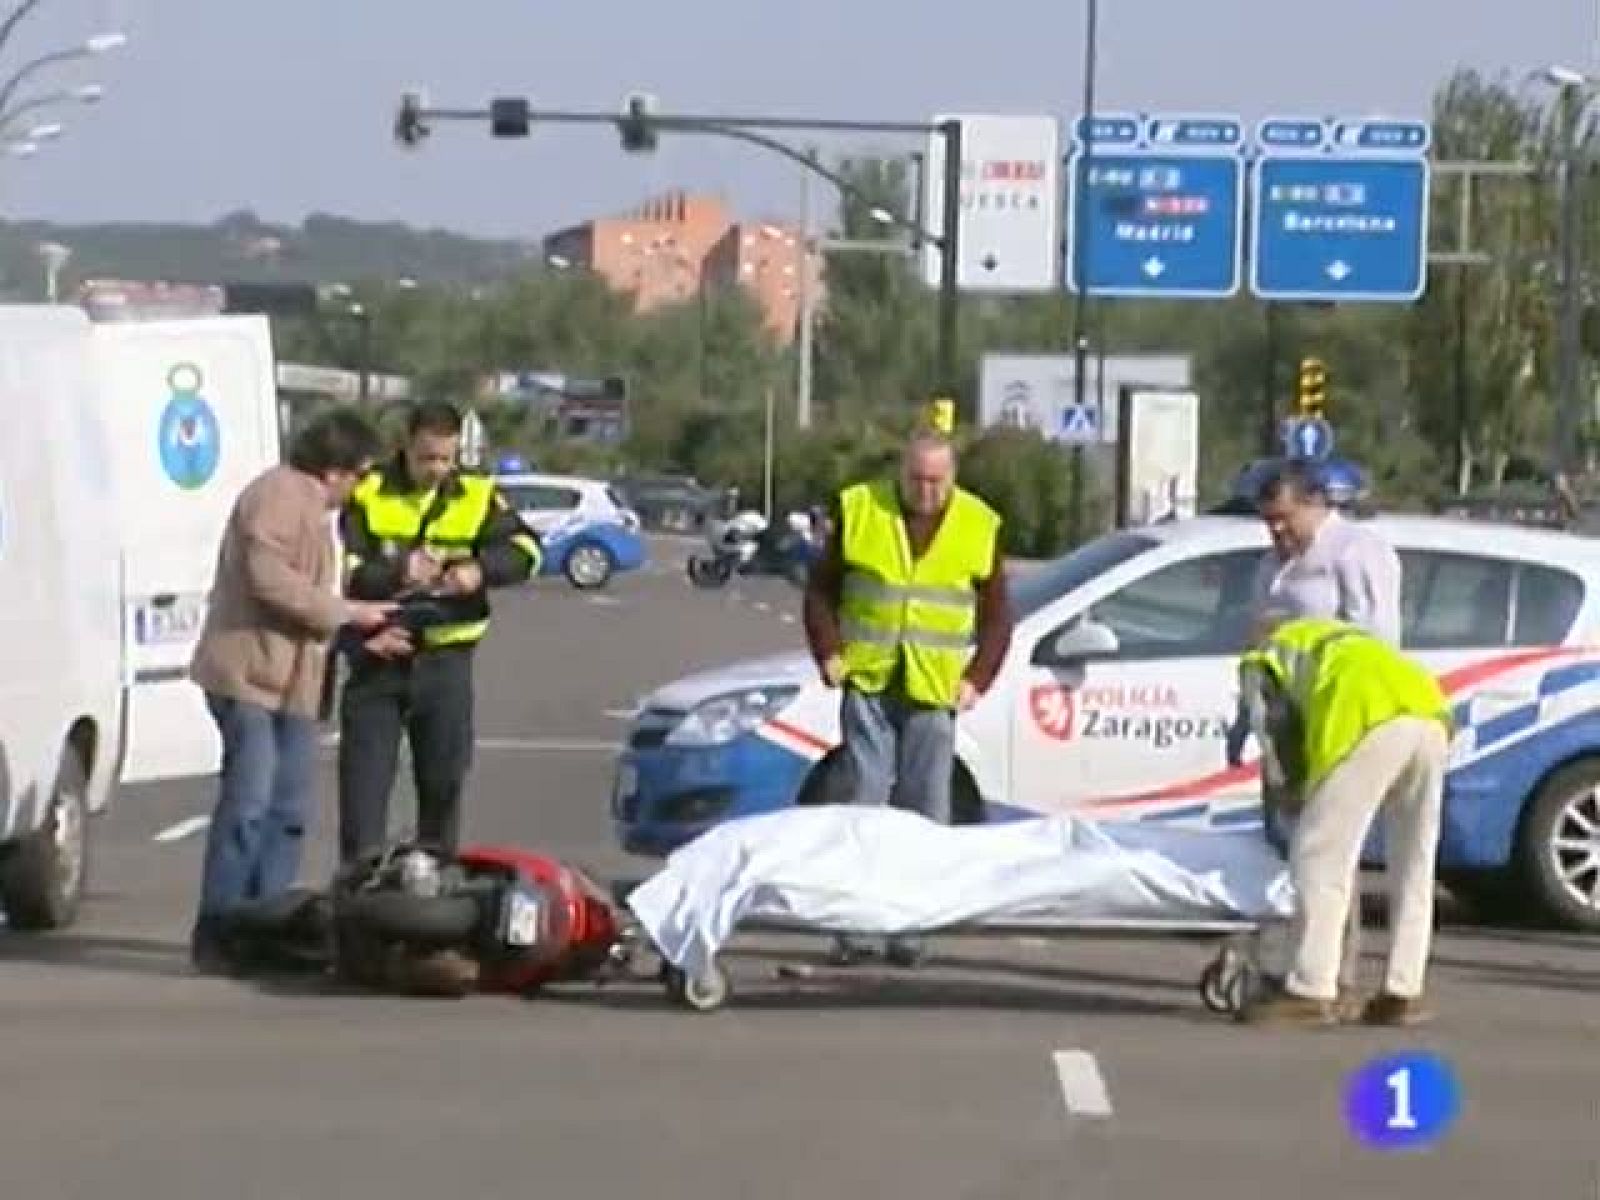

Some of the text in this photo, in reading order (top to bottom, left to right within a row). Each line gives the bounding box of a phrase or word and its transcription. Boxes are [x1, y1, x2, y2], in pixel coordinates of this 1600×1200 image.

[960, 191, 1039, 210] UESCA
[1115, 222, 1195, 241] Madrid
[1081, 709, 1229, 748] Zaragoza
